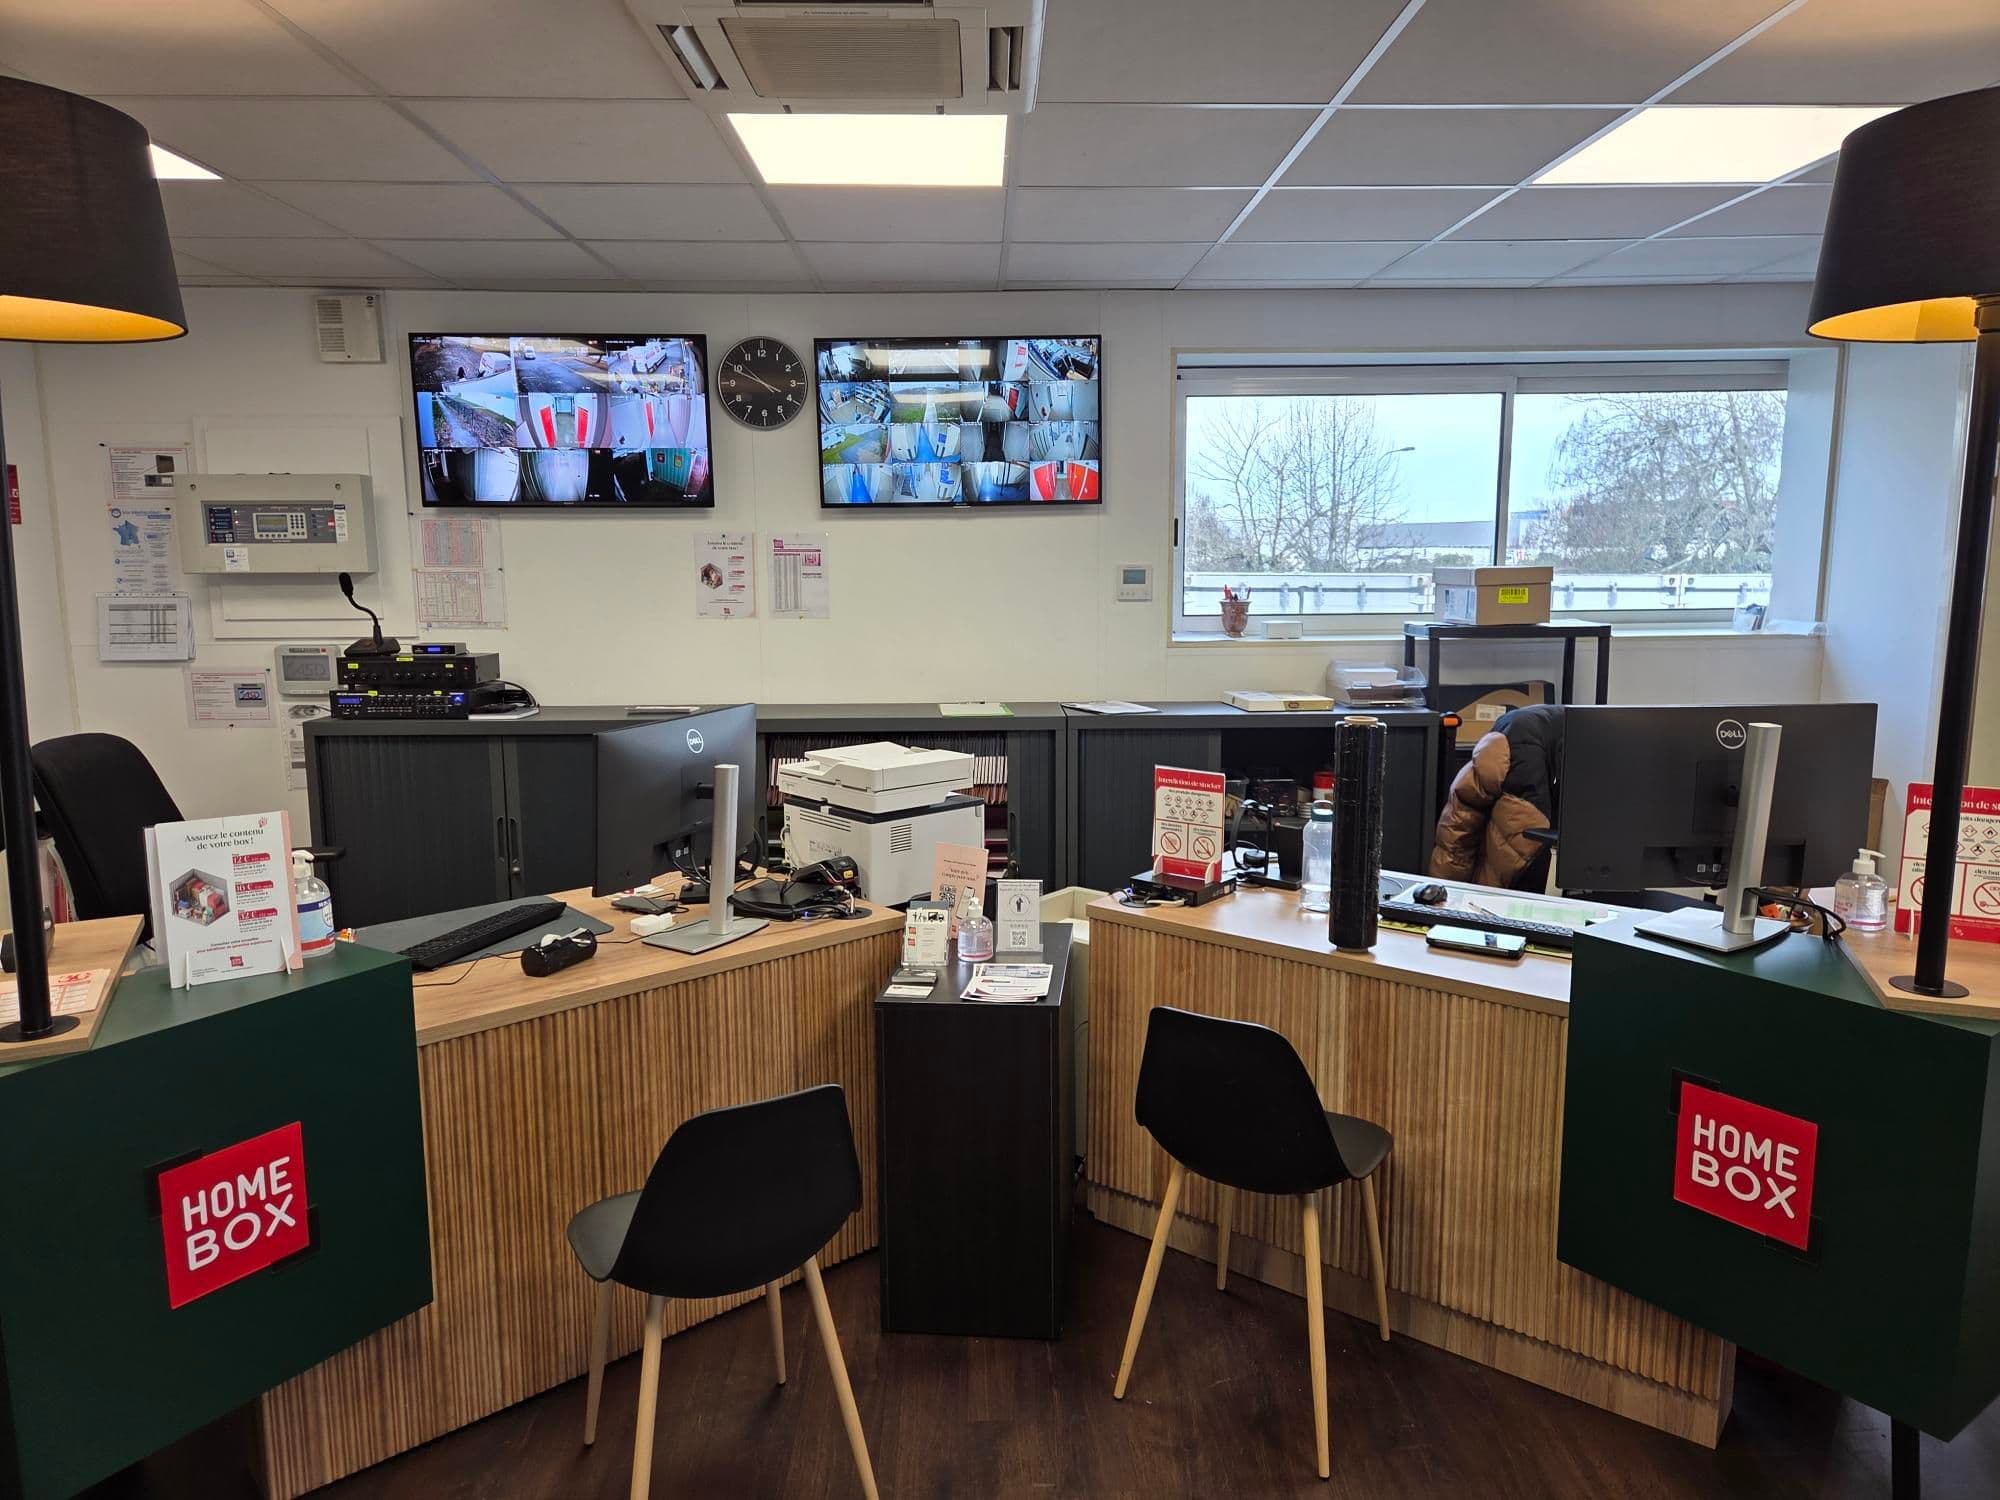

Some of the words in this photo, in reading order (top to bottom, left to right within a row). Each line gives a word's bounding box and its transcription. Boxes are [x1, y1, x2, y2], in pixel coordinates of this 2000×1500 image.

[744, 353, 751, 361] 11
[757, 349, 767, 358] 12
[775, 353, 779, 361] 1
[733, 364, 743, 373] 10
[785, 364, 792, 372] 2
[729, 379, 736, 387] 9
[790, 379, 797, 387] 3
[735, 394, 742, 402] 8
[786, 393, 793, 402] 4
[745, 405, 753, 413] 7
[761, 409, 768, 417] 6
[777, 405, 783, 413] 5
[1720, 730, 1743, 738] DELL
[689, 737, 702, 745] DELL
[1976, 801, 1990, 810] de
[185, 833, 218, 842] Assurez
[220, 831, 228, 839] le
[229, 828, 264, 838] contenu
[196, 842, 208, 850] de
[209, 840, 232, 849] votre
[1693, 1113, 1800, 1182] HOME
[1691, 1150, 1797, 1219] BOX
[181, 1155, 293, 1232] HOME
[186, 1193, 296, 1272] BOX
